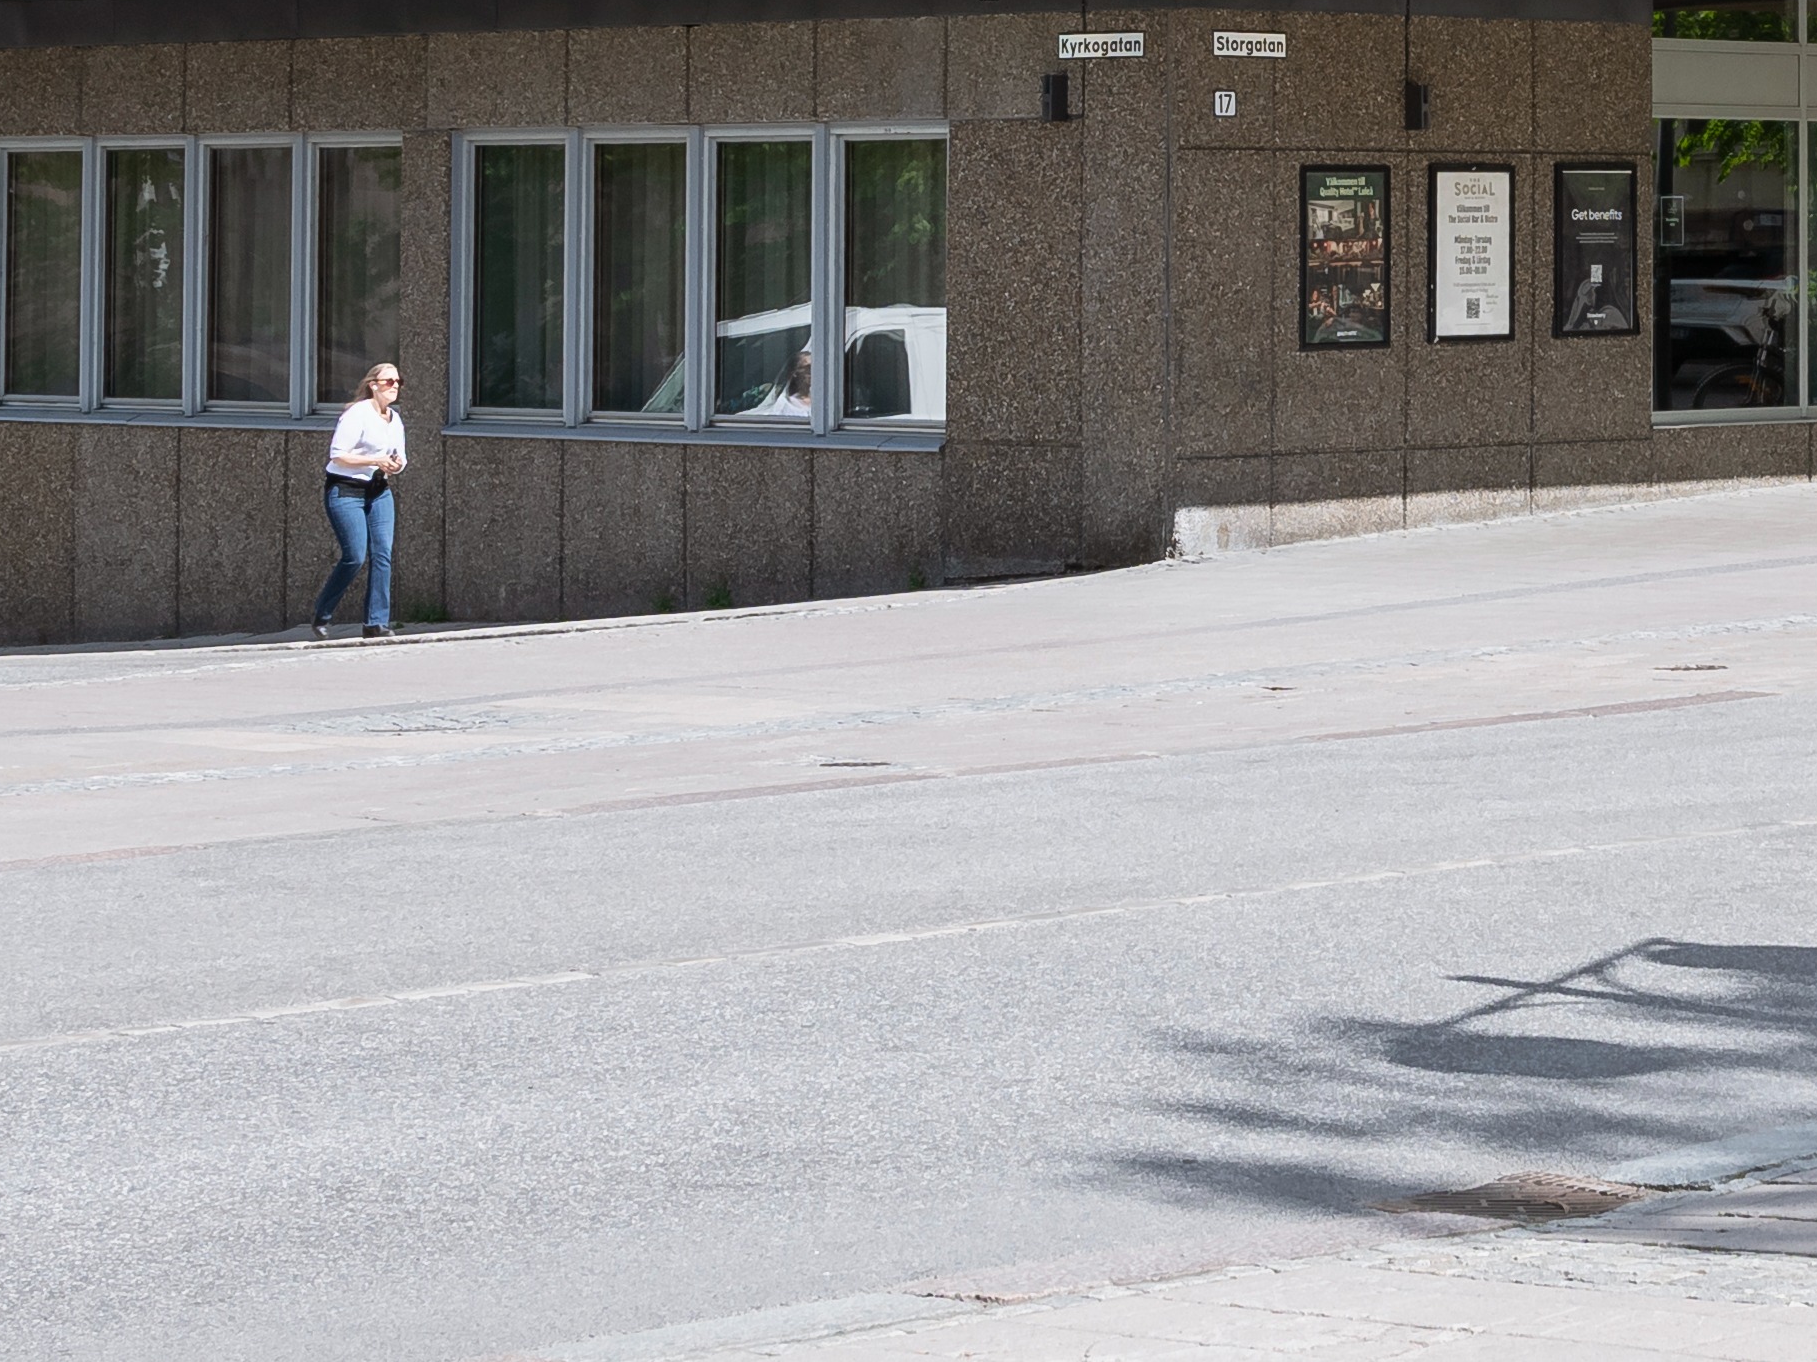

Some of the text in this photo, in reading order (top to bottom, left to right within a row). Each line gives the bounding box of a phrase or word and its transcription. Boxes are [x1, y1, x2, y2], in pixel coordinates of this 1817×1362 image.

[1061, 37, 1141, 57] Kyrkogatan
[1216, 36, 1284, 55] Storgatan
[1218, 94, 1233, 113] 17
[1319, 187, 1339, 197] Quality
[1454, 182, 1495, 196] SOCIAL
[1448, 215, 1456, 223] The
[1457, 215, 1470, 223] Social
[1571, 209, 1622, 220] Get benefits
